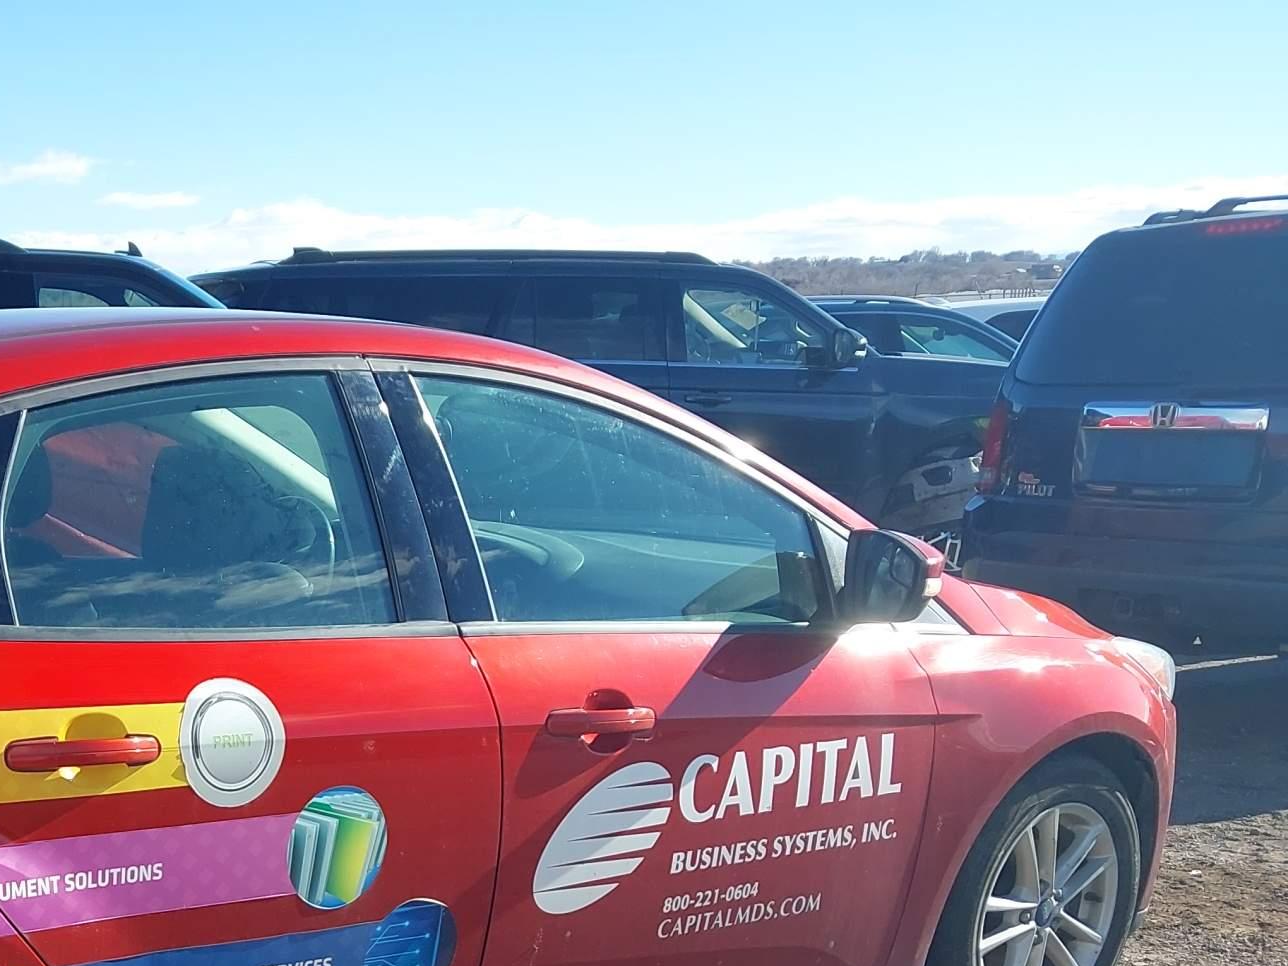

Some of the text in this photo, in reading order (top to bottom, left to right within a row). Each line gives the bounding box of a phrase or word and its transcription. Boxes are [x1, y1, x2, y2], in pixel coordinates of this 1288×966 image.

[1016, 484, 1056, 496] PILOT
[213, 733, 253, 749] PRINT
[679, 732, 902, 823] CAPITAL
[670, 819, 897, 874] BUSINESS SYSTEMS, INC.
[64, 863, 163, 892] SOLUTIONS
[663, 881, 759, 913] 800-221-0604
[657, 892, 822, 939] CAPITALMDS.COM
